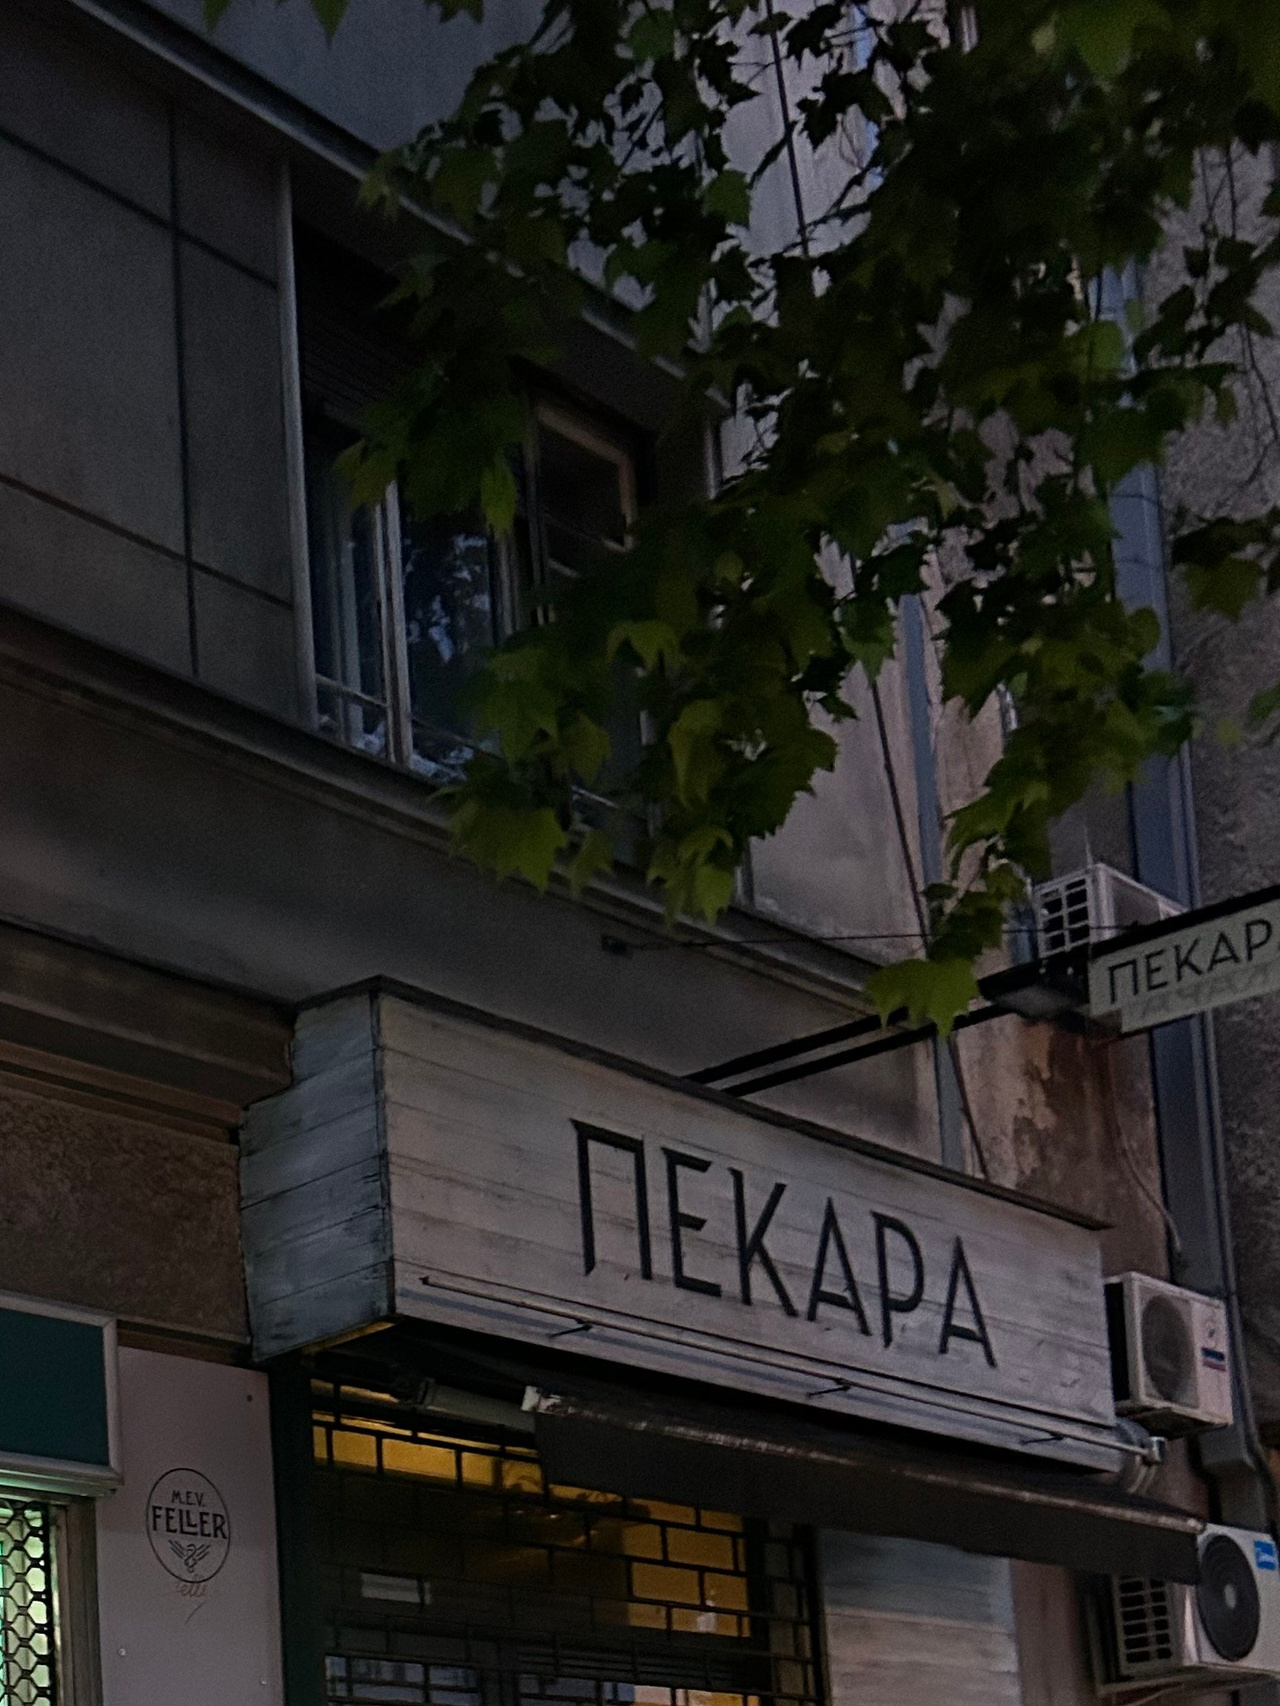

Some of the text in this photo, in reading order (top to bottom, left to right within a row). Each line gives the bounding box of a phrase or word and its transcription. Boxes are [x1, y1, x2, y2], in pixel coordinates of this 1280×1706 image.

[1107, 918, 1280, 1005] ПЕКАР
[569, 1118, 998, 1369] ПЕКАРА
[151, 1505, 228, 1540] FELLER
